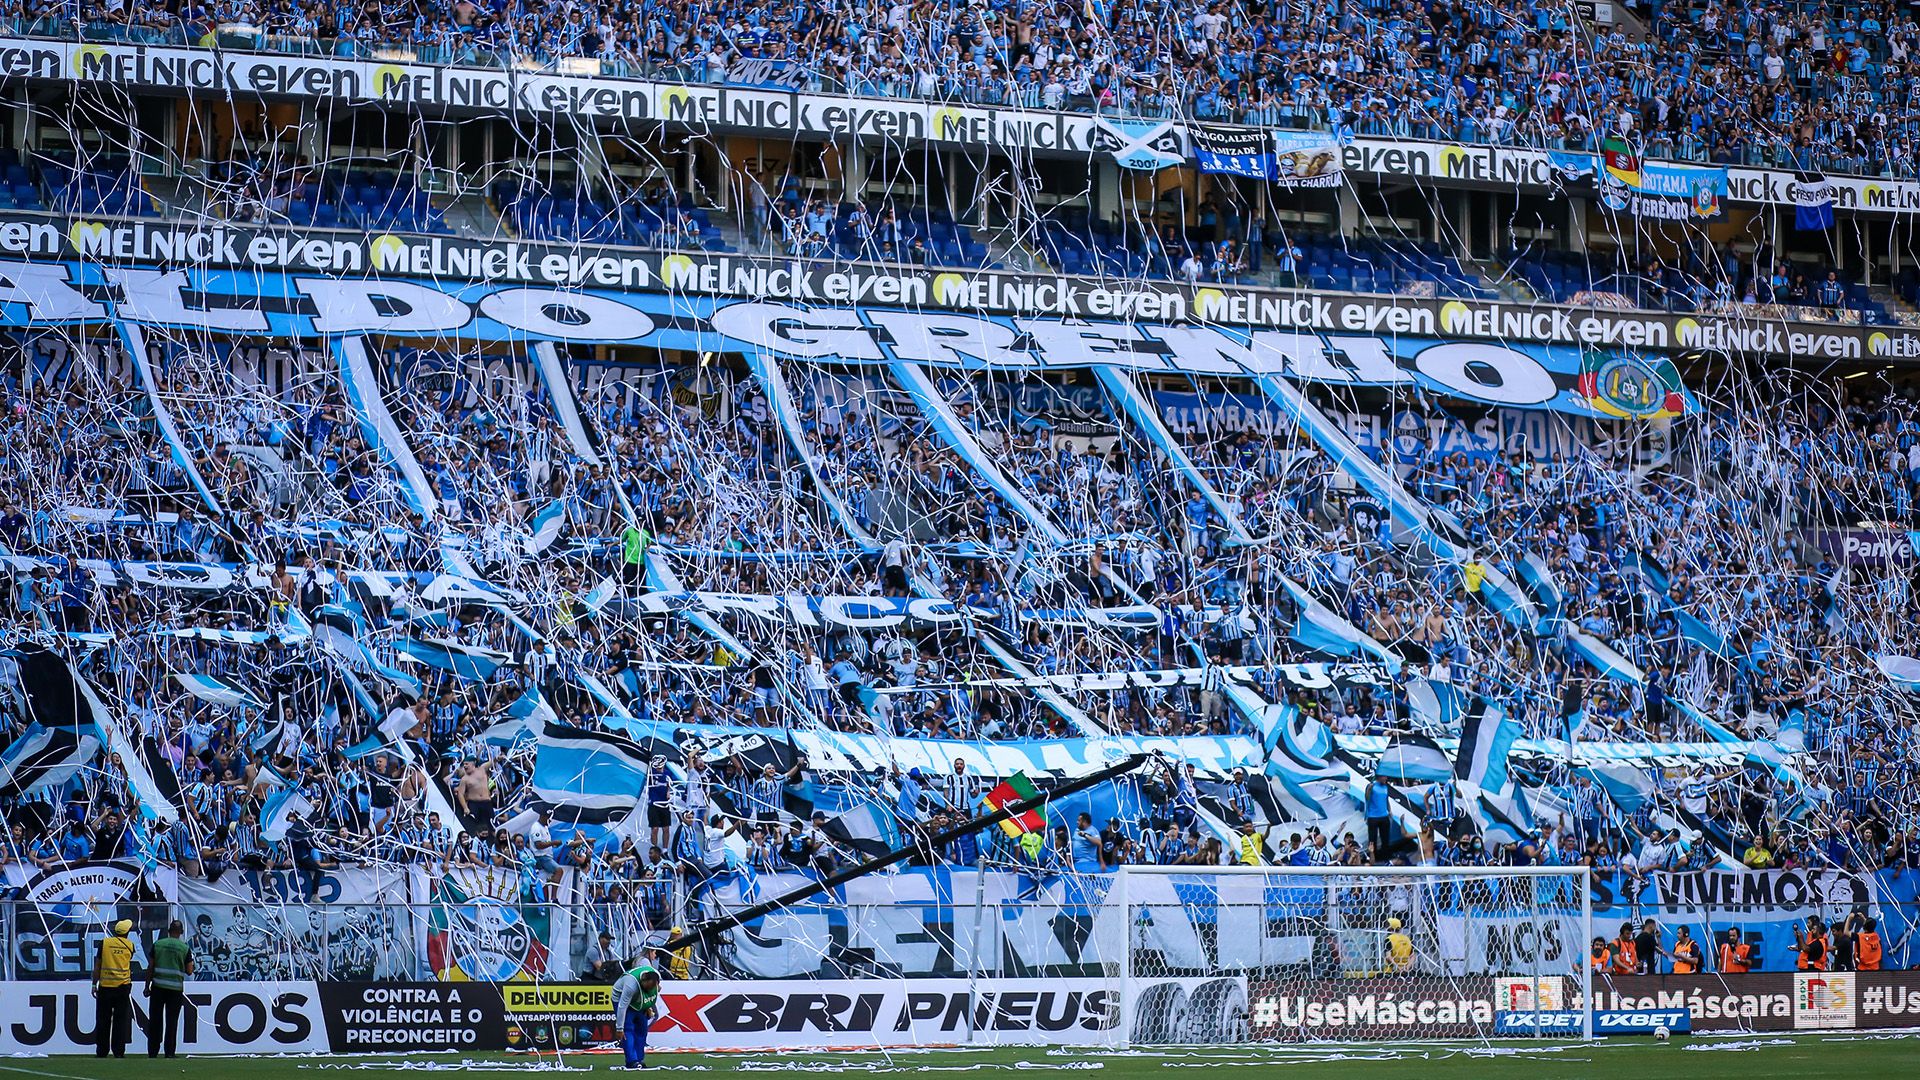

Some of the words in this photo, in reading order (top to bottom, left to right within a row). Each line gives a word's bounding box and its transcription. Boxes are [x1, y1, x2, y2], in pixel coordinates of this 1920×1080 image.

[0, 47, 60, 77] en
[83, 48, 237, 90] MELNICK
[249, 65, 360, 98] even
[383, 65, 529, 109] MELNICK
[542, 84, 649, 117] even
[669, 90, 813, 131] MELNICK
[822, 105, 931, 137] even
[942, 110, 1075, 150] MELNICK
[1300, 171, 1343, 188] CHARRUA
[1341, 145, 1436, 176] even
[1447, 149, 1550, 184] MELNIC
[1787, 185, 1858, 213] een
[79, 222, 240, 264] MELNICK
[249, 237, 361, 271] even
[379, 238, 530, 278] MELNICK
[540, 252, 650, 287] even
[669, 256, 814, 297] MELNICK
[823, 271, 926, 304] even
[939, 274, 1080, 313] MELNICK
[1087, 287, 1187, 319] even
[1199, 290, 1333, 328] MELNICK
[1341, 303, 1435, 334] even
[1447, 303, 1573, 341] MELNICK
[1580, 316, 1668, 347] even
[1680, 320, 1782, 353] MELNICK
[1790, 332, 1861, 358] even
[295, 276, 655, 340] DO
[37, 881, 65, 902] TRAGO
[70, 874, 105, 887] ALENTO
[1657, 870, 1821, 915] VIVEMOS
[15, 929, 161, 973] GERA
[1486, 919, 1562, 966] NOS
[363, 988, 439, 1004] CONTRA
[446, 988, 461, 1003] A
[510, 991, 610, 1006] DENUNCIE:
[646, 993, 885, 1033] XBRI
[894, 991, 1121, 1032] PNEUS
[1254, 987, 1493, 1028] #UseMáscara
[1570, 987, 1791, 1018] #UseMáscara
[11, 993, 312, 1045] JUTOS
[341, 1005, 442, 1024] VIOLÊNCIA
[451, 1008, 462, 1023] E
[466, 1008, 482, 1023] O
[1502, 1013, 1584, 1027] 1XBET
[1599, 1013, 1684, 1027] 1XBET
[346, 1028, 477, 1044] PRECONCEITO
